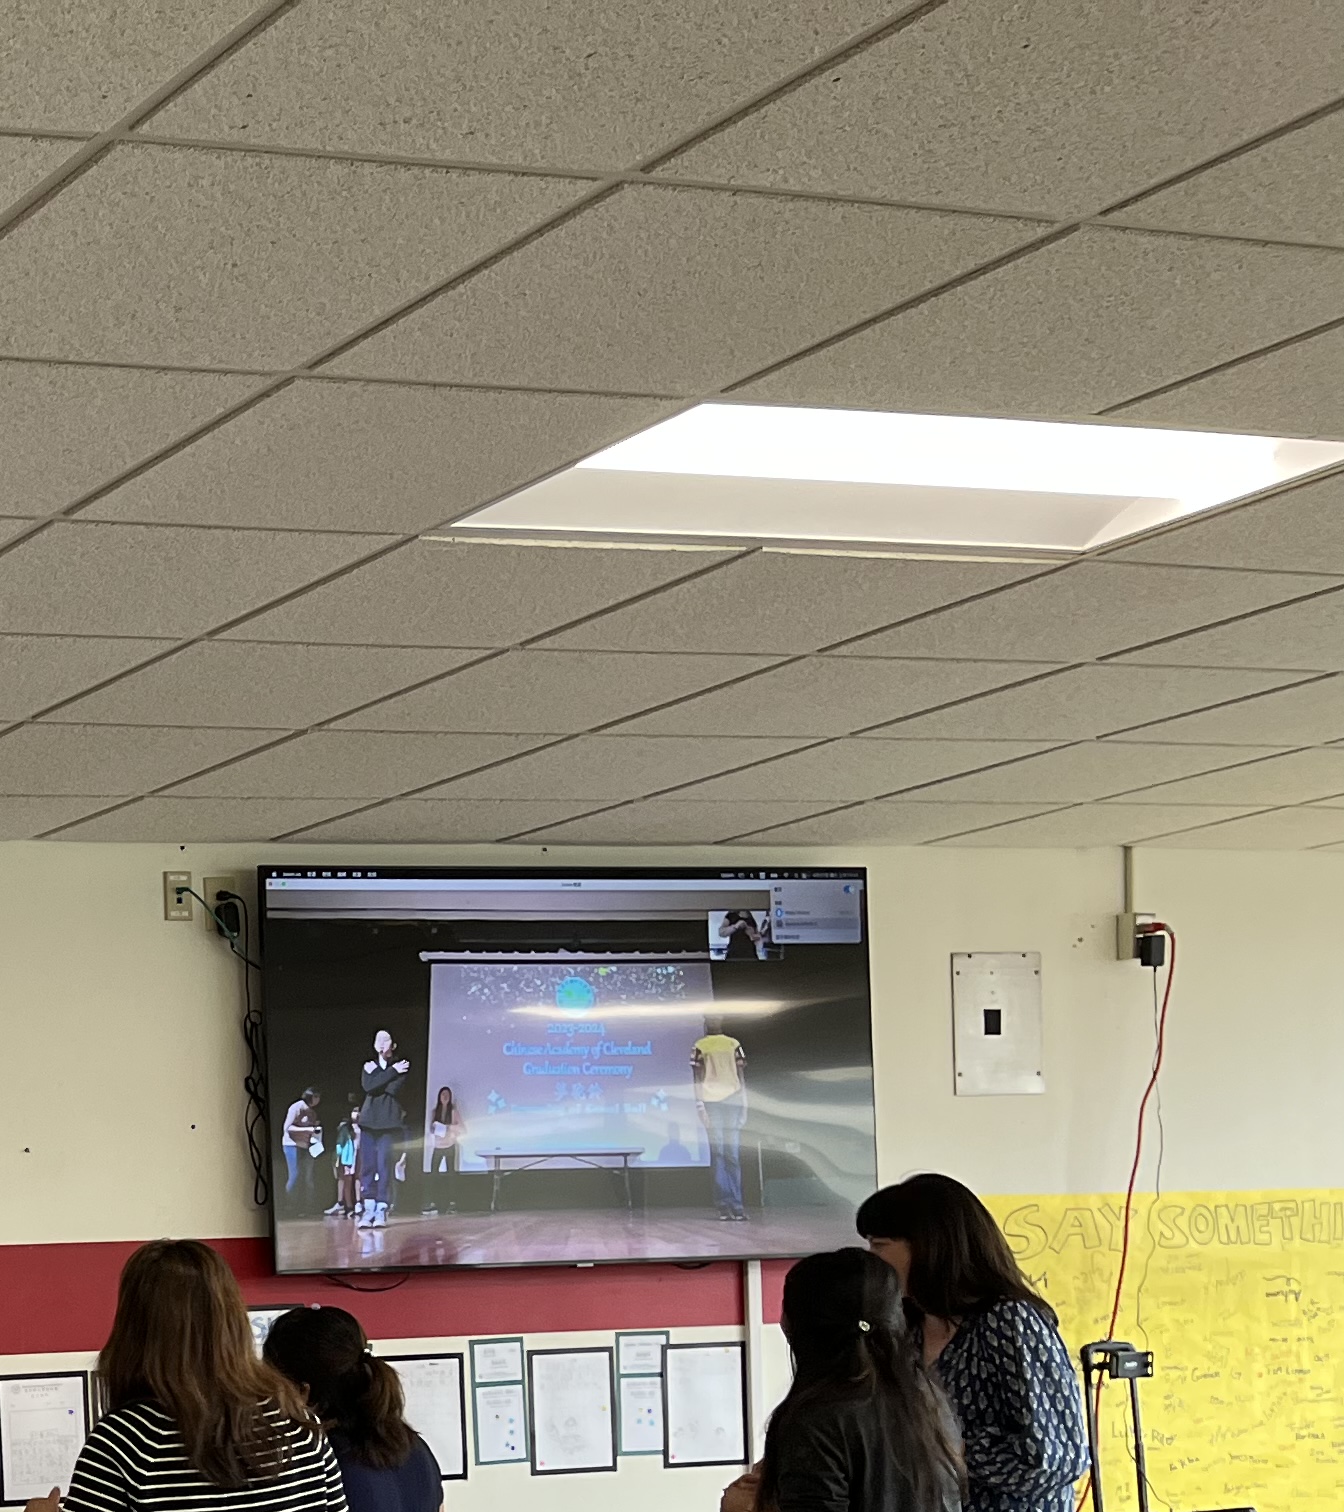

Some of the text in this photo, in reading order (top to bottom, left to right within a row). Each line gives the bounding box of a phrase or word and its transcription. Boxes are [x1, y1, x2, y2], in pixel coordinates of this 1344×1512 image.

[547, 1023, 606, 1036] 2023-2024
[603, 1040, 652, 1056] Cleveland
[582, 1062, 633, 1079] Ceremony
[1003, 1199, 1344, 1260] SAY SOMETHI
